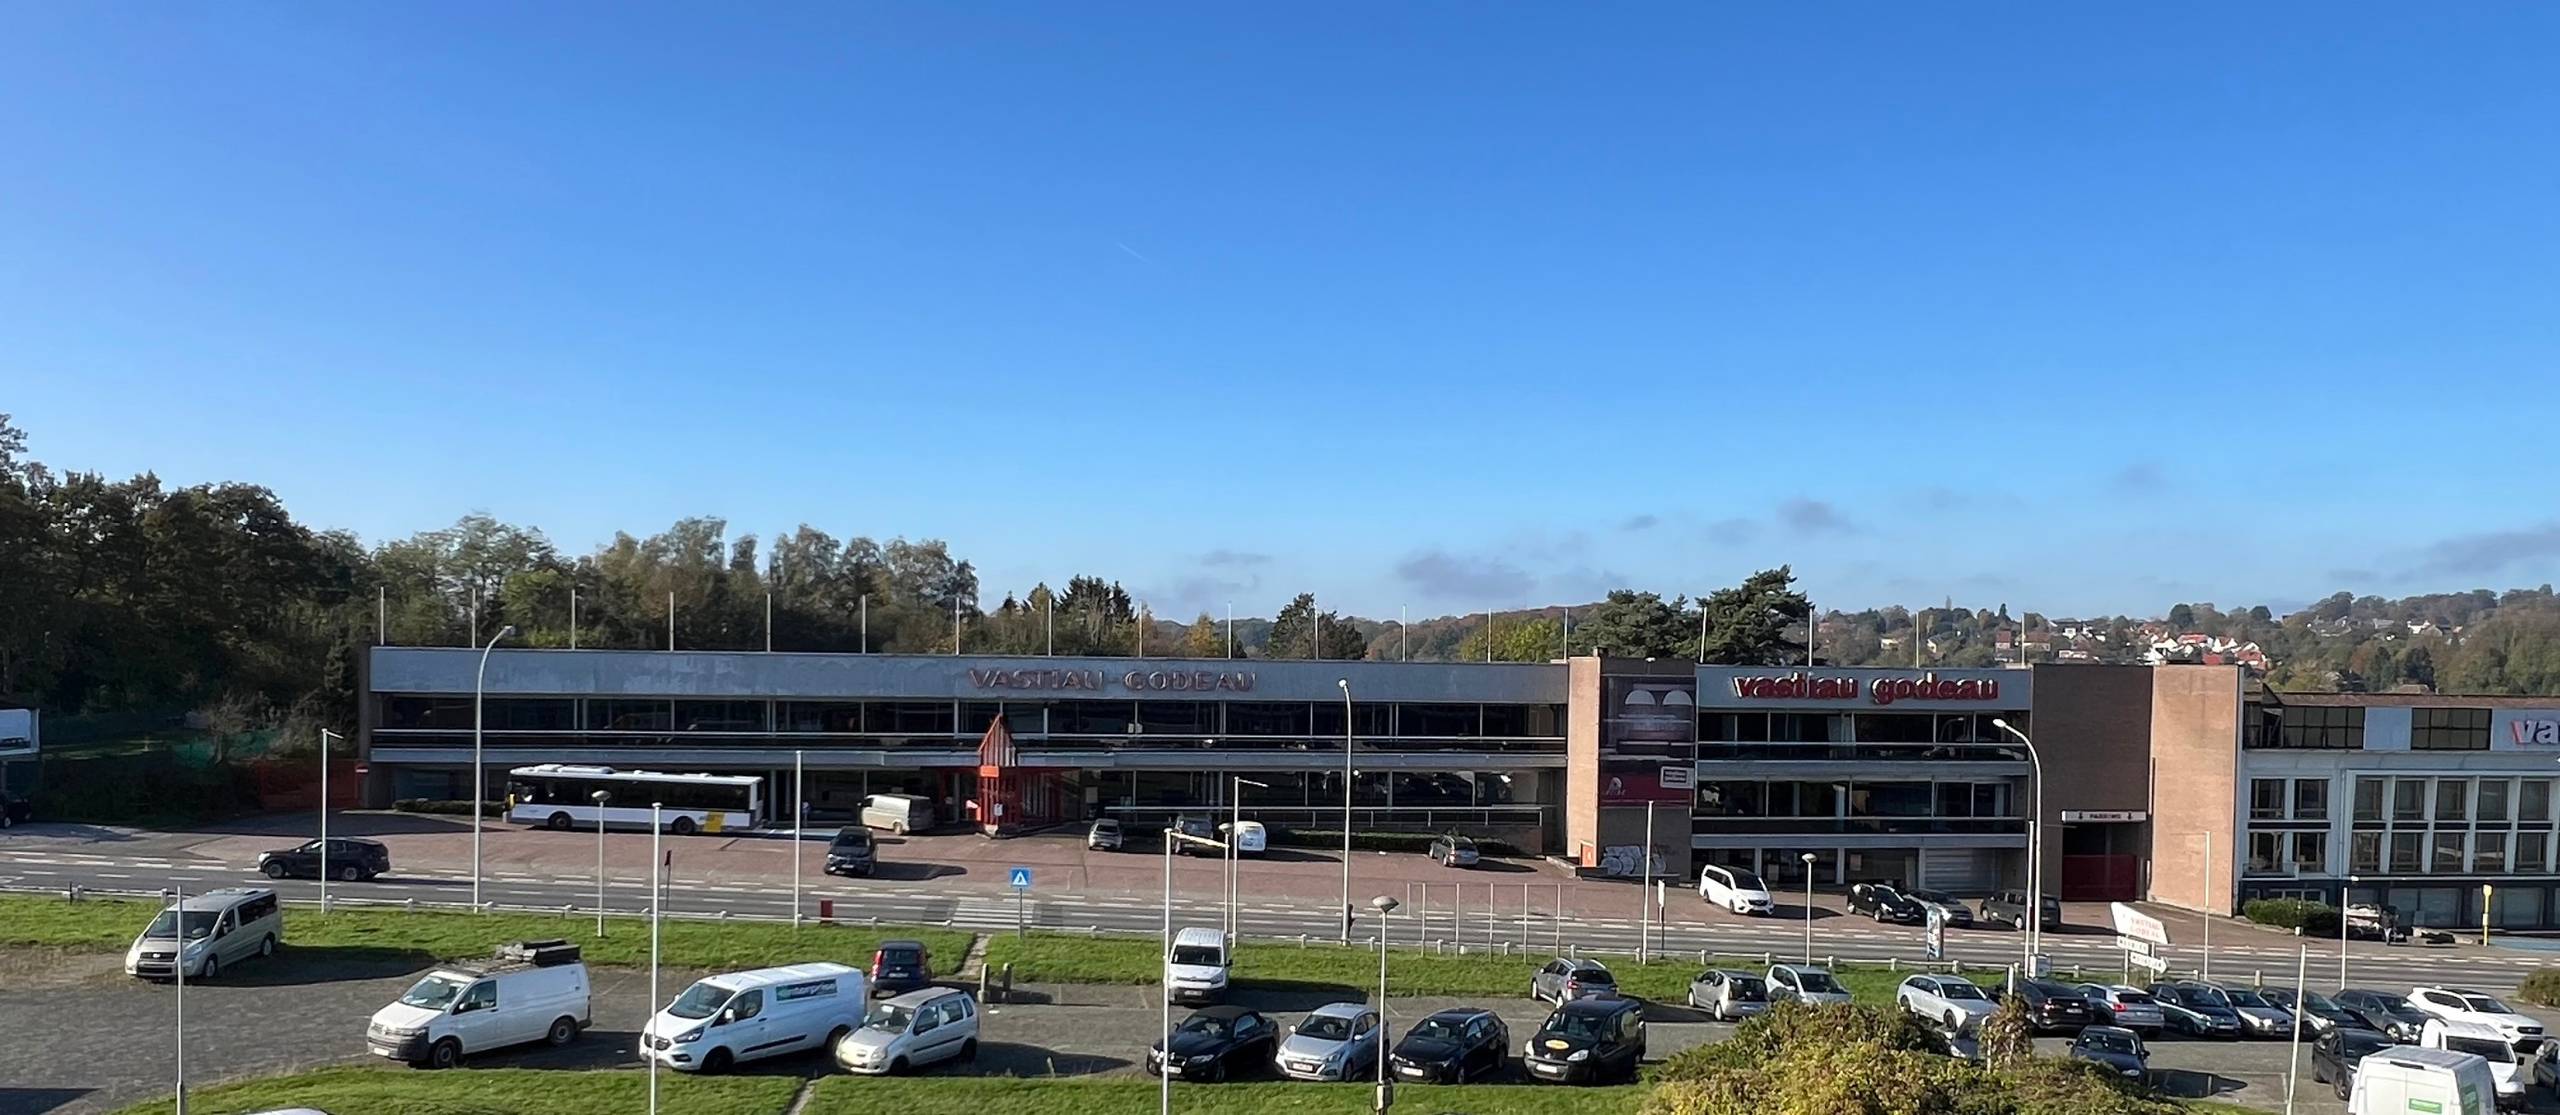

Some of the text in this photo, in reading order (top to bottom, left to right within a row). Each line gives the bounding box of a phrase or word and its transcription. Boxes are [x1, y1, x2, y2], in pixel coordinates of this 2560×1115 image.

[968, 669, 1257, 692] VASTIAU GODEAU
[1732, 672, 2000, 705] vastiau godeau
